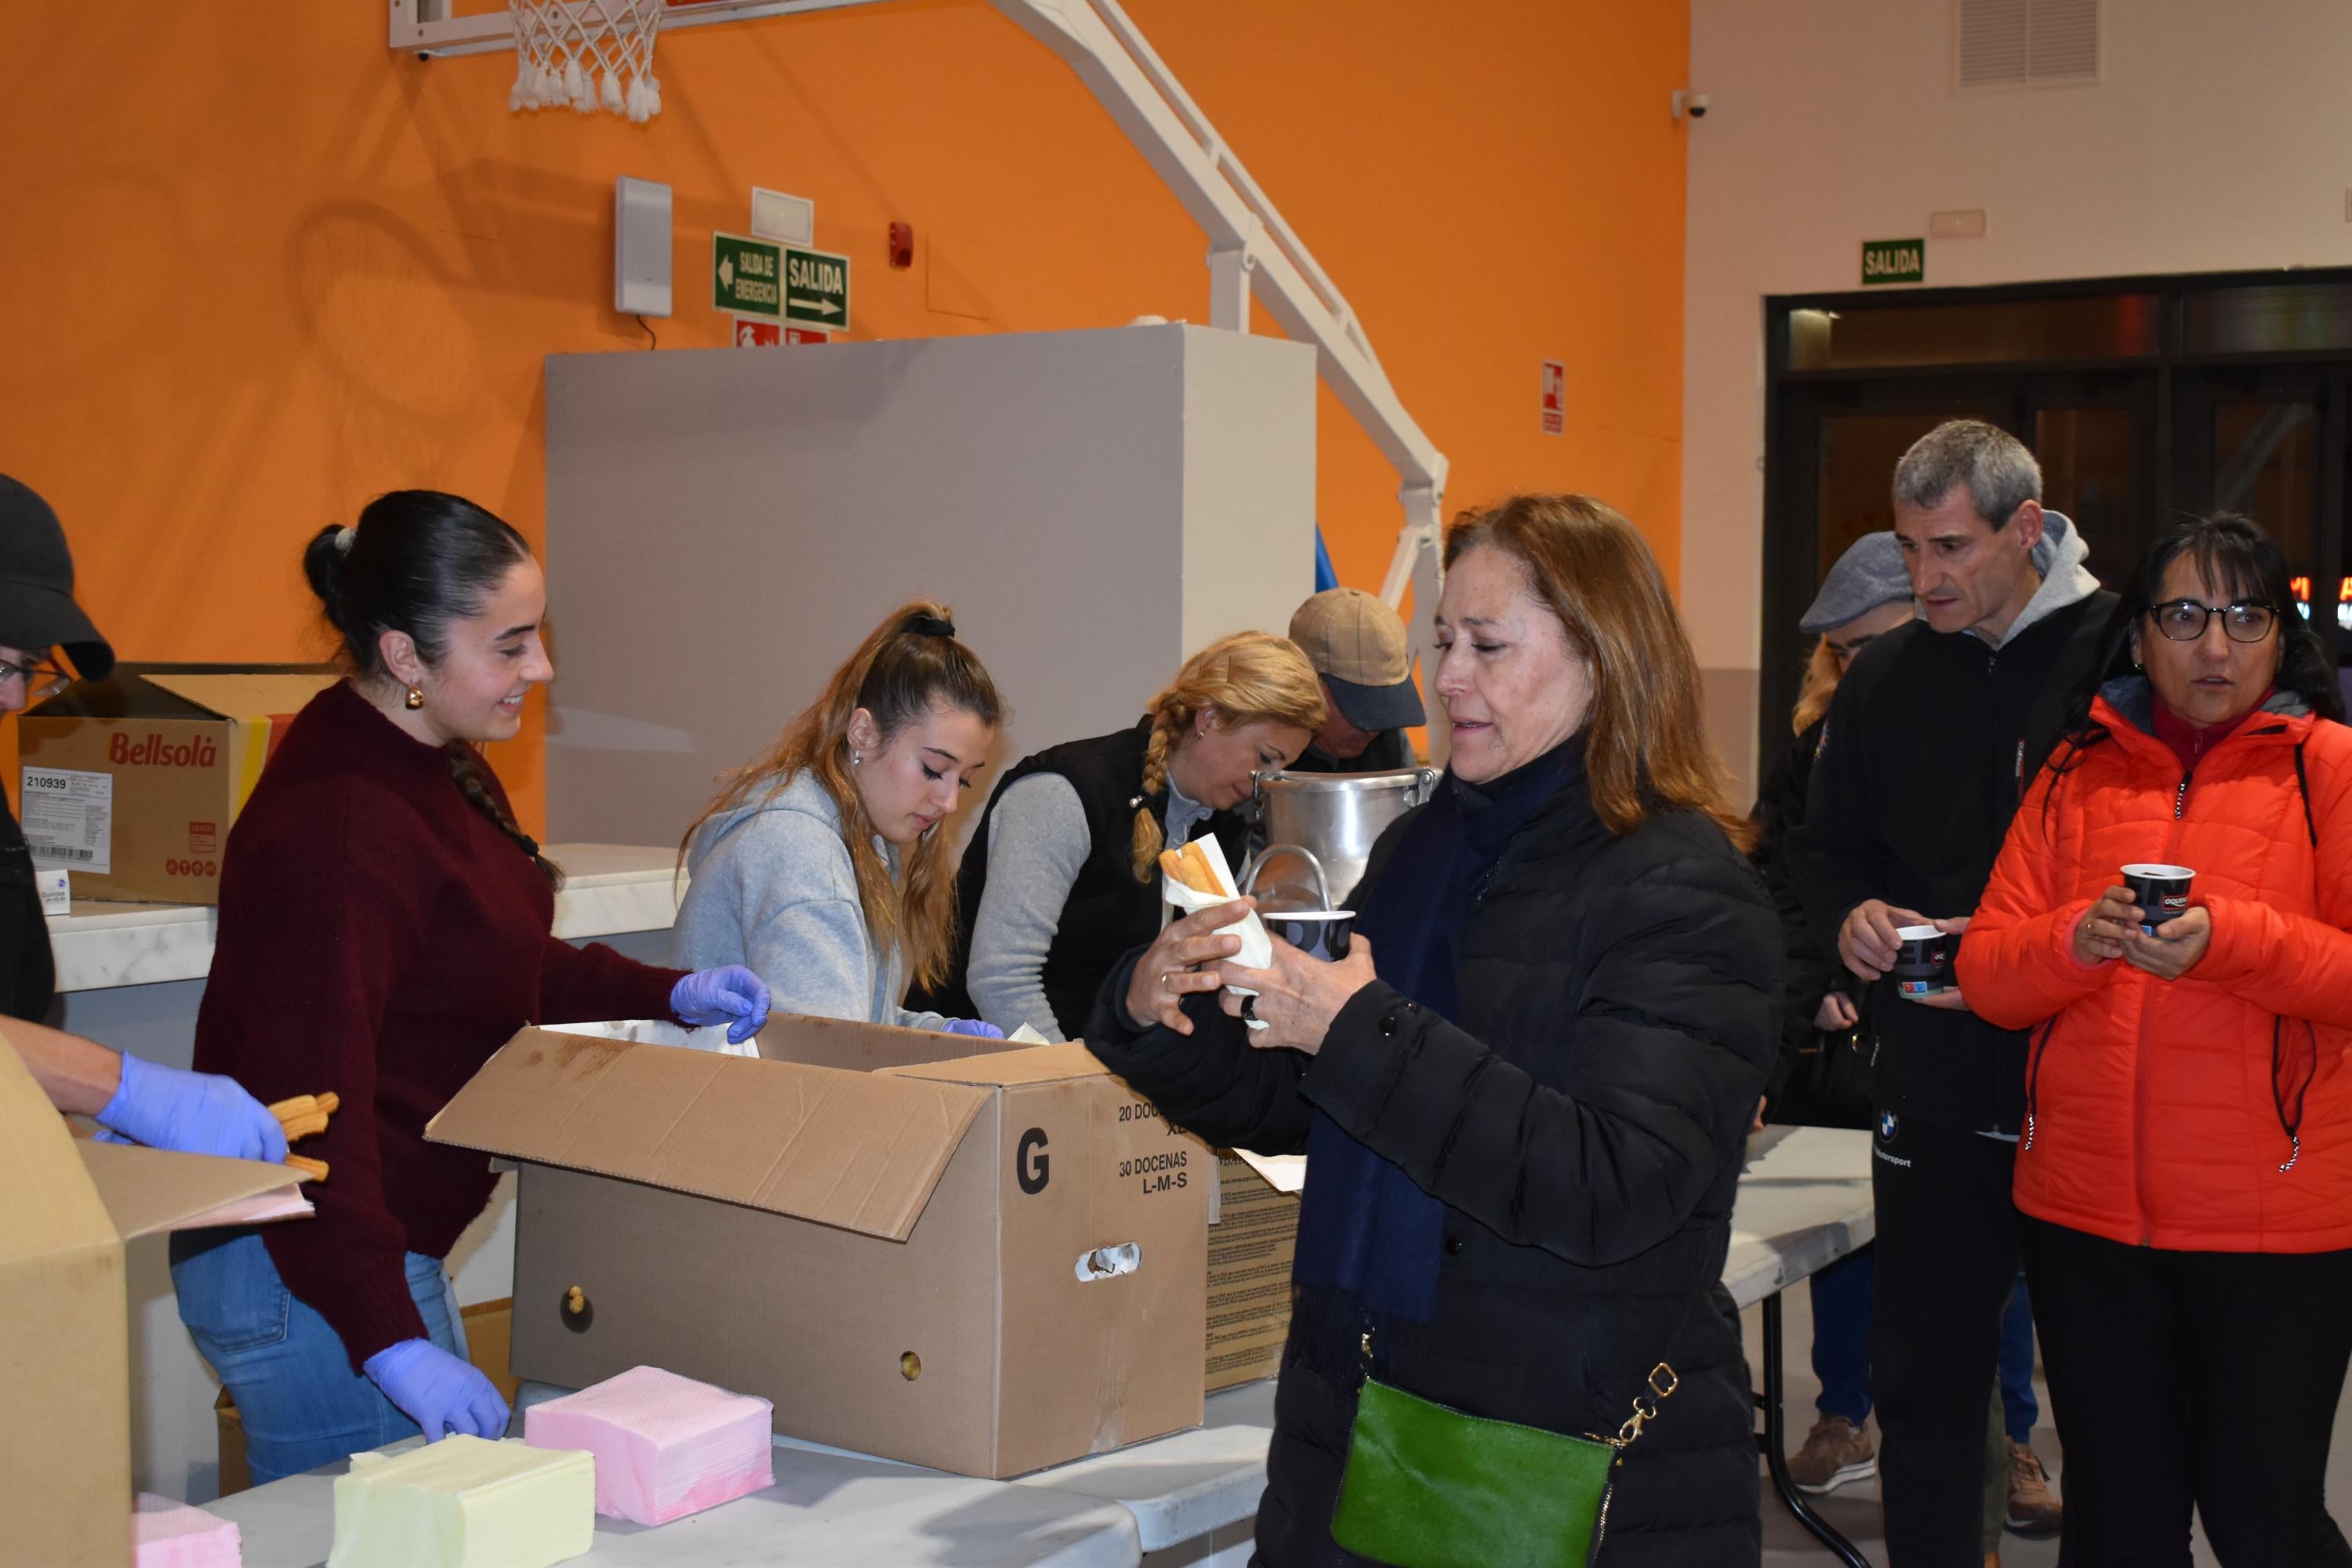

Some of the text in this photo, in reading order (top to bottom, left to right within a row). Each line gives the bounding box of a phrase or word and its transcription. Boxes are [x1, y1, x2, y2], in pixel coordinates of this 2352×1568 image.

[740, 252, 774, 278] SALIDA DE
[1866, 249, 1920, 274] SALIDA
[789, 257, 844, 296] SALIDA
[735, 278, 778, 304] EMERGENCIA
[27, 776, 67, 789] 210939
[1119, 1102, 1163, 1122] 20 DOC
[1017, 1127, 1050, 1195] G
[1119, 1151, 1187, 1178] 30 DOCENAS
[1143, 1172, 1187, 1194] L-M-S
